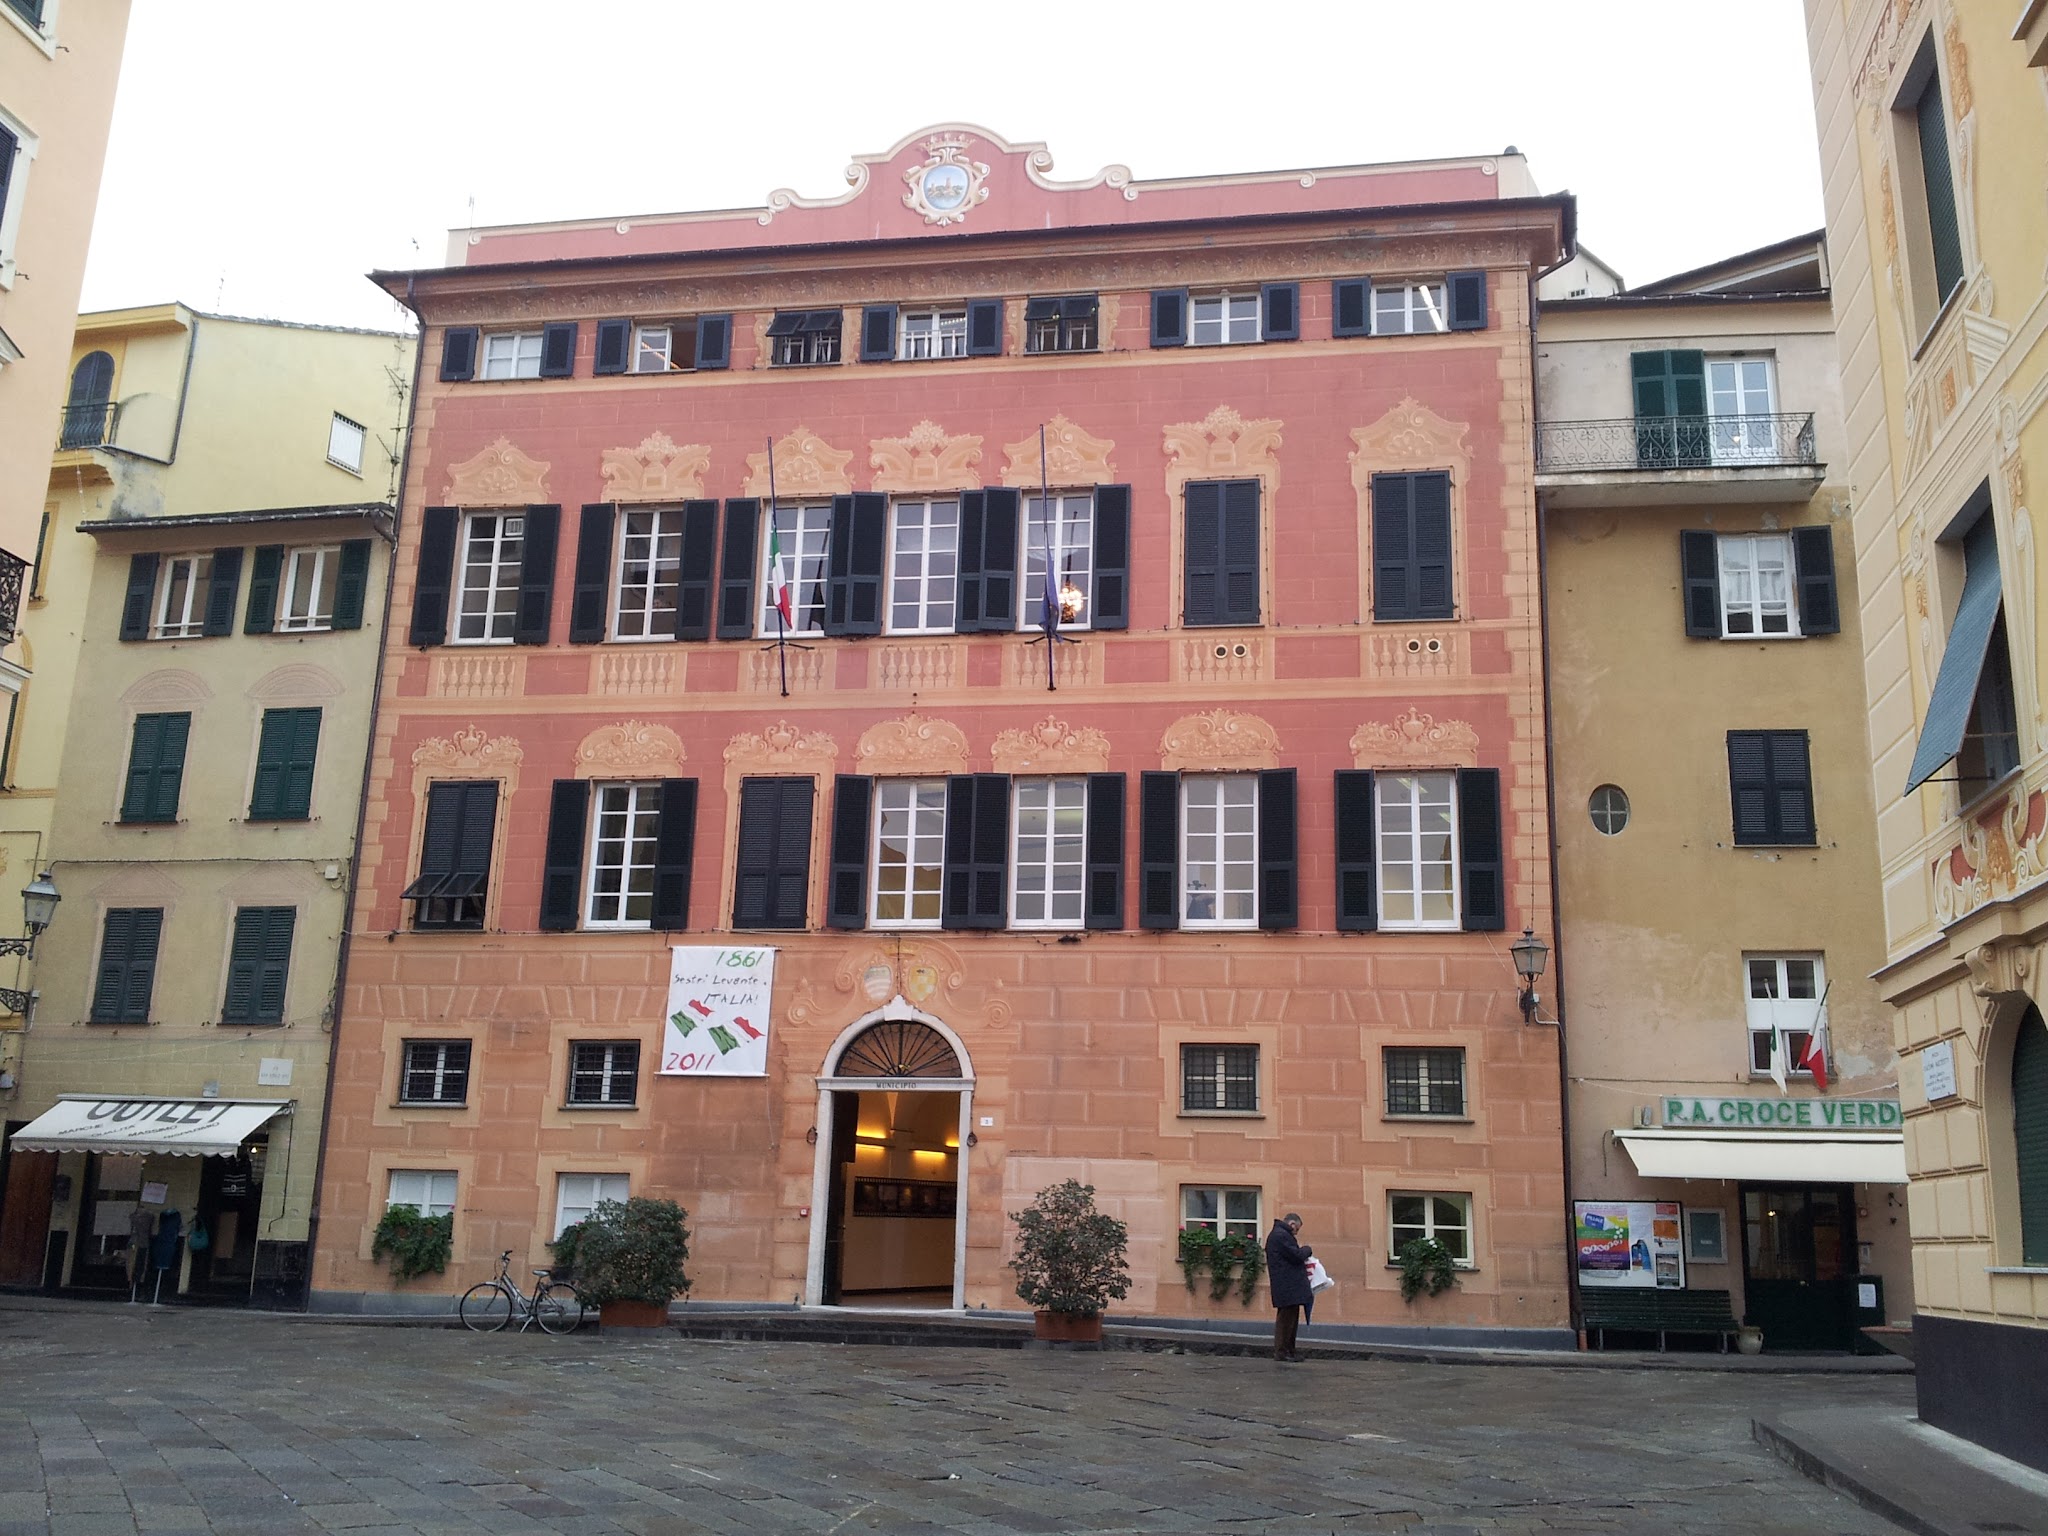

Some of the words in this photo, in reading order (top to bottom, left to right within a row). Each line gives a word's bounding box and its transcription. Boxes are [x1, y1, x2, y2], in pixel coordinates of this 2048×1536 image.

[715, 950, 765, 967] 1861
[673, 973, 709, 984] Sestri
[703, 993, 759, 1005] ITALIA!
[665, 1052, 715, 1070] 2011
[1667, 1100, 1714, 1124] P.A.
[1718, 1101, 1811, 1125] CROCE
[1820, 1102, 1904, 1125] VERD
[58, 1124, 104, 1136] MARCHE
[128, 1125, 178, 1138] MASSIMO
